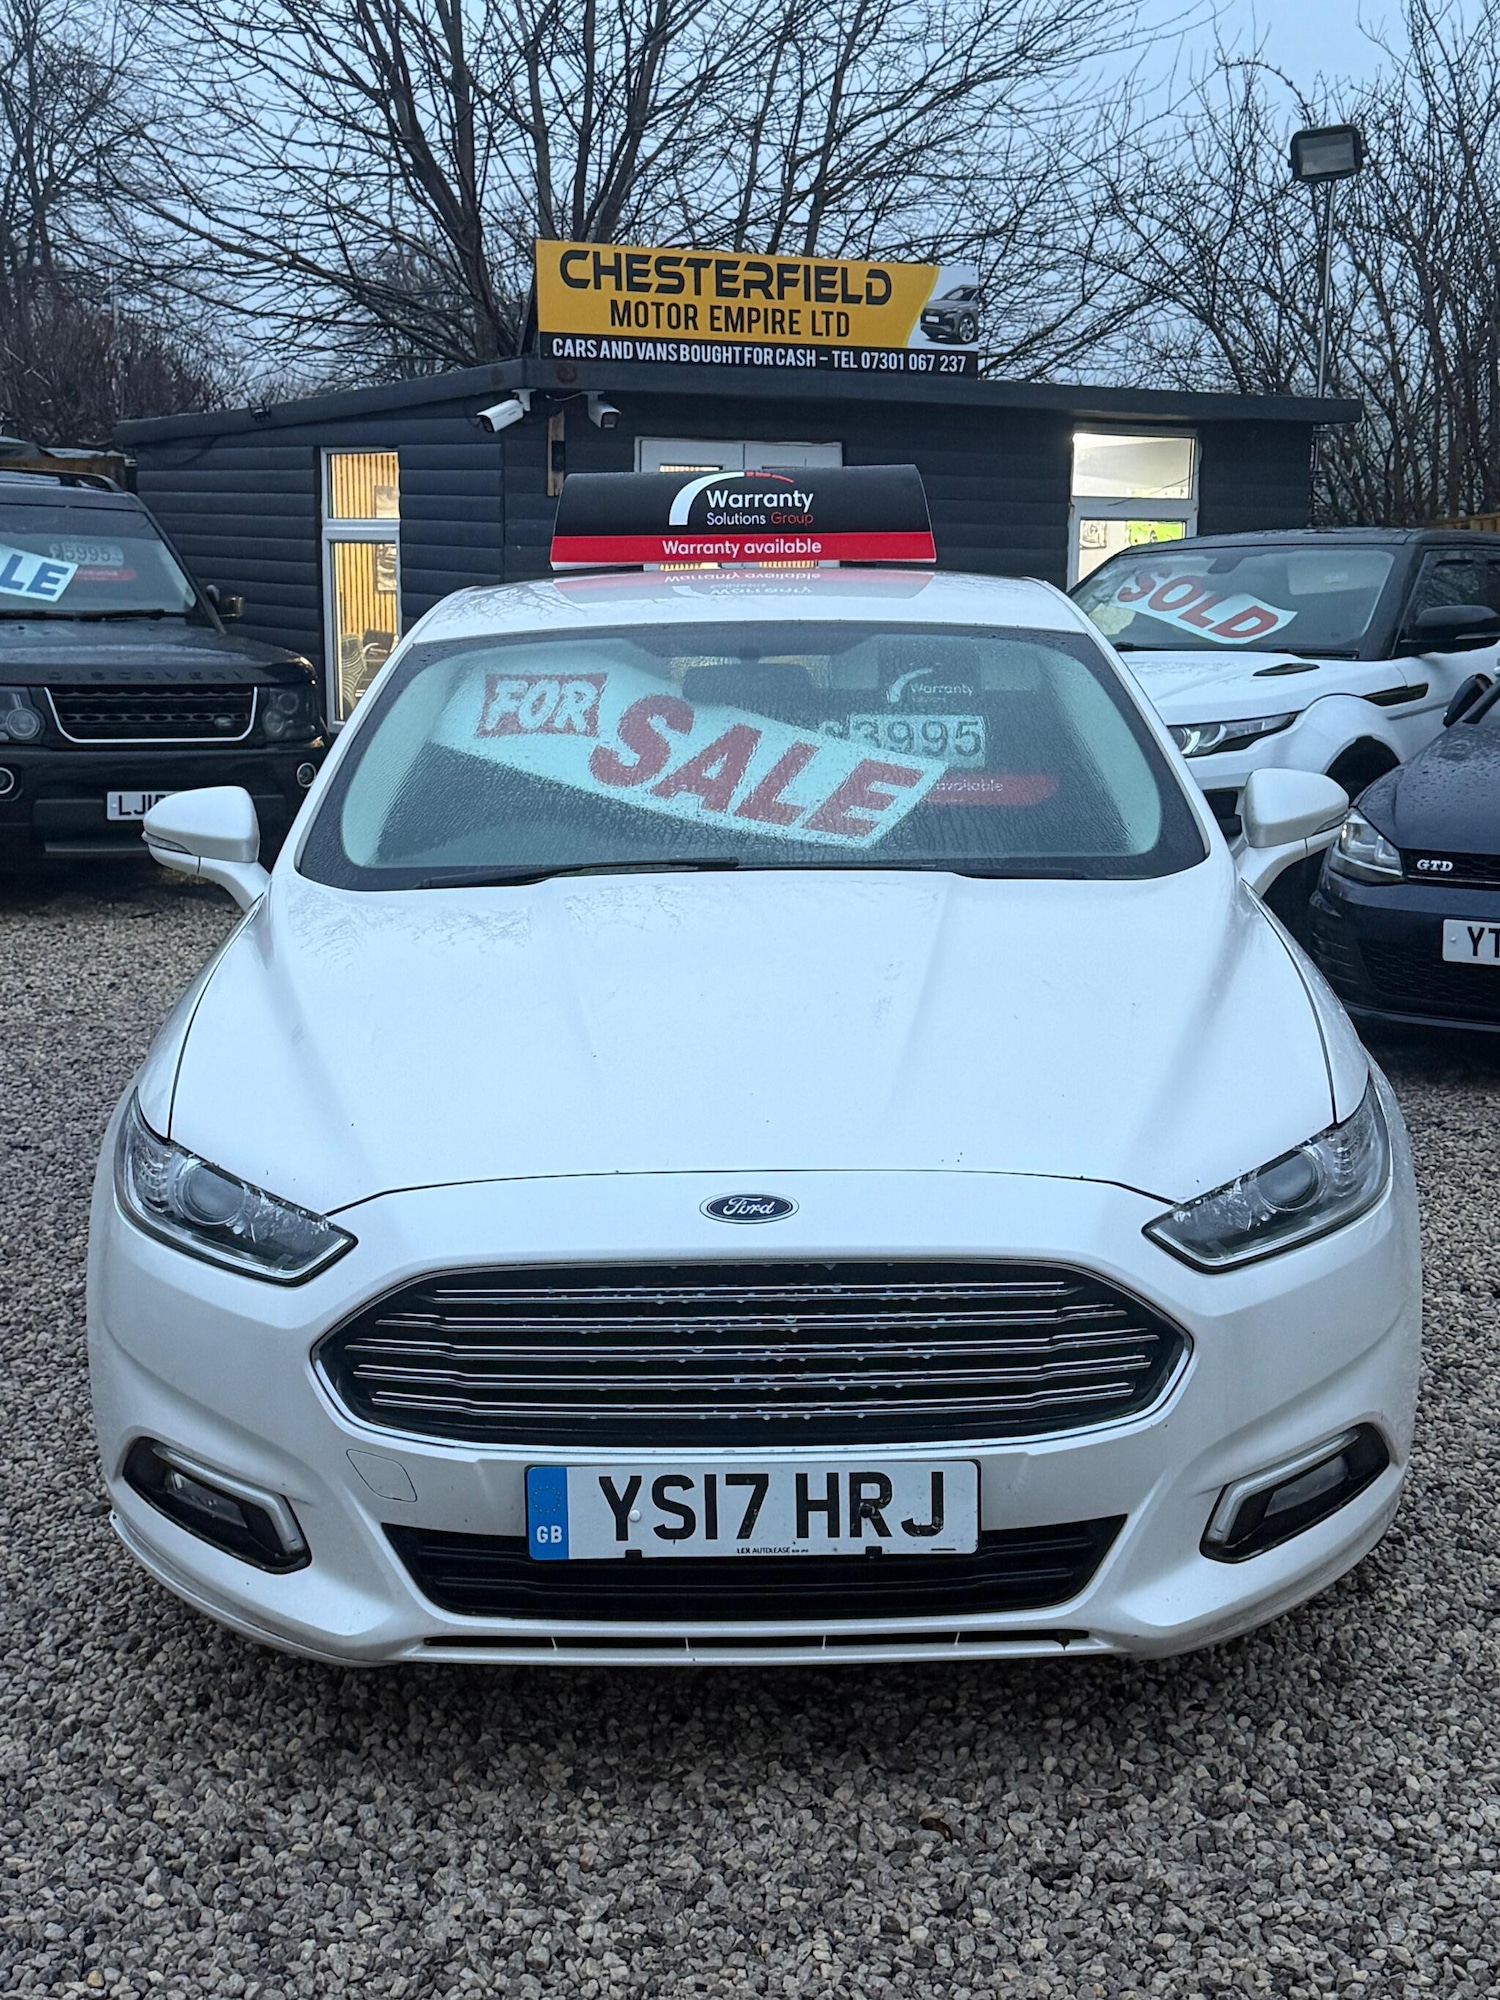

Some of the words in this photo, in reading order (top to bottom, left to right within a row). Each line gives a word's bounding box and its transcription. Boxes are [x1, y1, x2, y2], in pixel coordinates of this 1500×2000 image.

[559, 249, 892, 305] CHESTERFIELD
[611, 299, 699, 331] MOTOR
[710, 305, 801, 336] EMPIRE
[811, 310, 850, 338] LTD
[552, 338, 597, 359] CARS
[600, 340, 633, 360] AND
[636, 342, 678, 361] VANS
[680, 344, 742, 364] BOUGHT
[744, 347, 774, 366] FOR
[778, 348, 816, 367] CASH
[832, 350, 858, 369] TEL
[861, 351, 904, 370] 07301
[908, 353, 935, 371] 067
[939, 355, 966, 373] 237
[706, 489, 813, 512] Warranty
[707, 511, 766, 526] Solutions
[771, 511, 814, 526] Group
[662, 540, 740, 558] Warranty
[744, 539, 822, 554] available
[1116, 569, 1279, 639] SOLD
[911, 682, 974, 696] Warranty
[485, 678, 600, 733] FOR
[588, 694, 926, 838] SALE
[936, 778, 1004, 792] available
[1416, 859, 1454, 872] GTD
[1467, 926, 1500, 959] YT
[722, 1197, 776, 1215] Ford
[599, 1472, 770, 1542] YS17
[795, 1471, 944, 1539] HRJ
[536, 1525, 563, 1544] GB
[737, 1546, 751, 1554] LEX
[752, 1546, 790, 1554] AUTOLEASE
